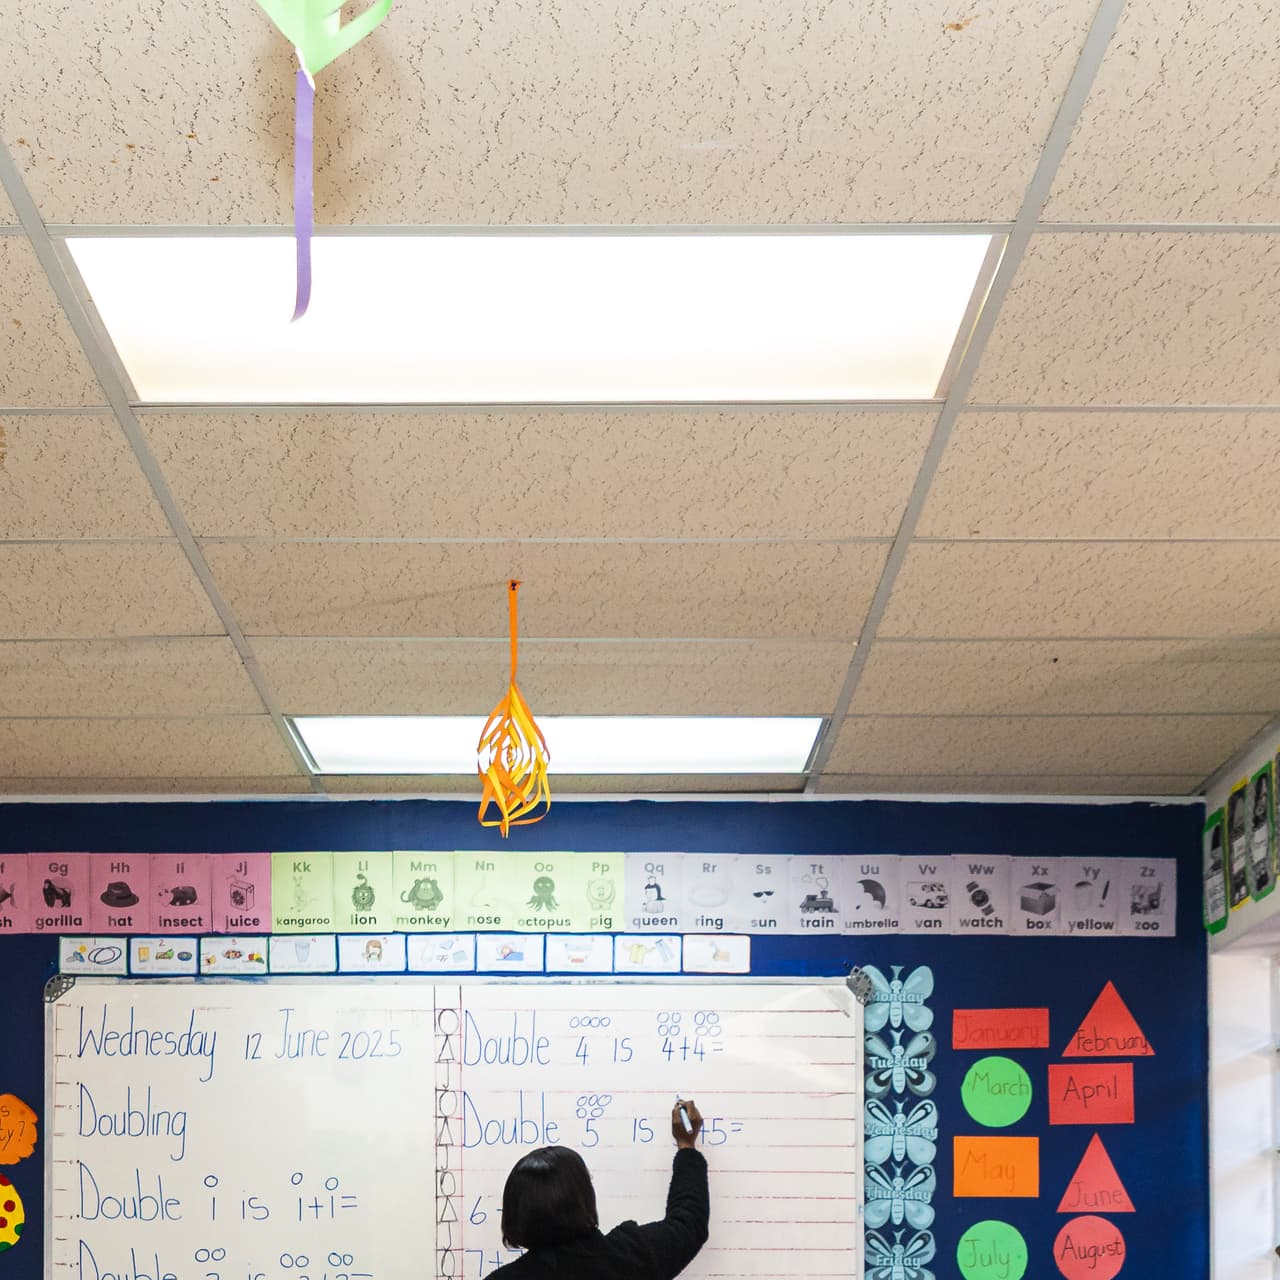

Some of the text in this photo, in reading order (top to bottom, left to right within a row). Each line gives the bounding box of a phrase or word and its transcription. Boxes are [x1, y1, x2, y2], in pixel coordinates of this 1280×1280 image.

[35, 914, 83, 929] gorilla
[225, 915, 260, 930] juice
[396, 914, 451, 929] monkey
[632, 915, 678, 928] queen
[800, 917, 835, 930] train
[959, 916, 1003, 930] watch
[77, 1003, 403, 1083] Wednesday 12 June 2025
[464, 1008, 552, 1067] Double
[575, 1035, 589, 1065] 4
[613, 1036, 634, 1062] is
[1075, 1027, 1148, 1055] February
[972, 1071, 1030, 1096] March
[1063, 1075, 1118, 1109] April
[78, 1083, 187, 1161] Doubling
[462, 1090, 654, 1148] Double 5 is
[78, 1161, 183, 1222] Double
[241, 1193, 270, 1220] is
[1061, 1235, 1123, 1269] August
